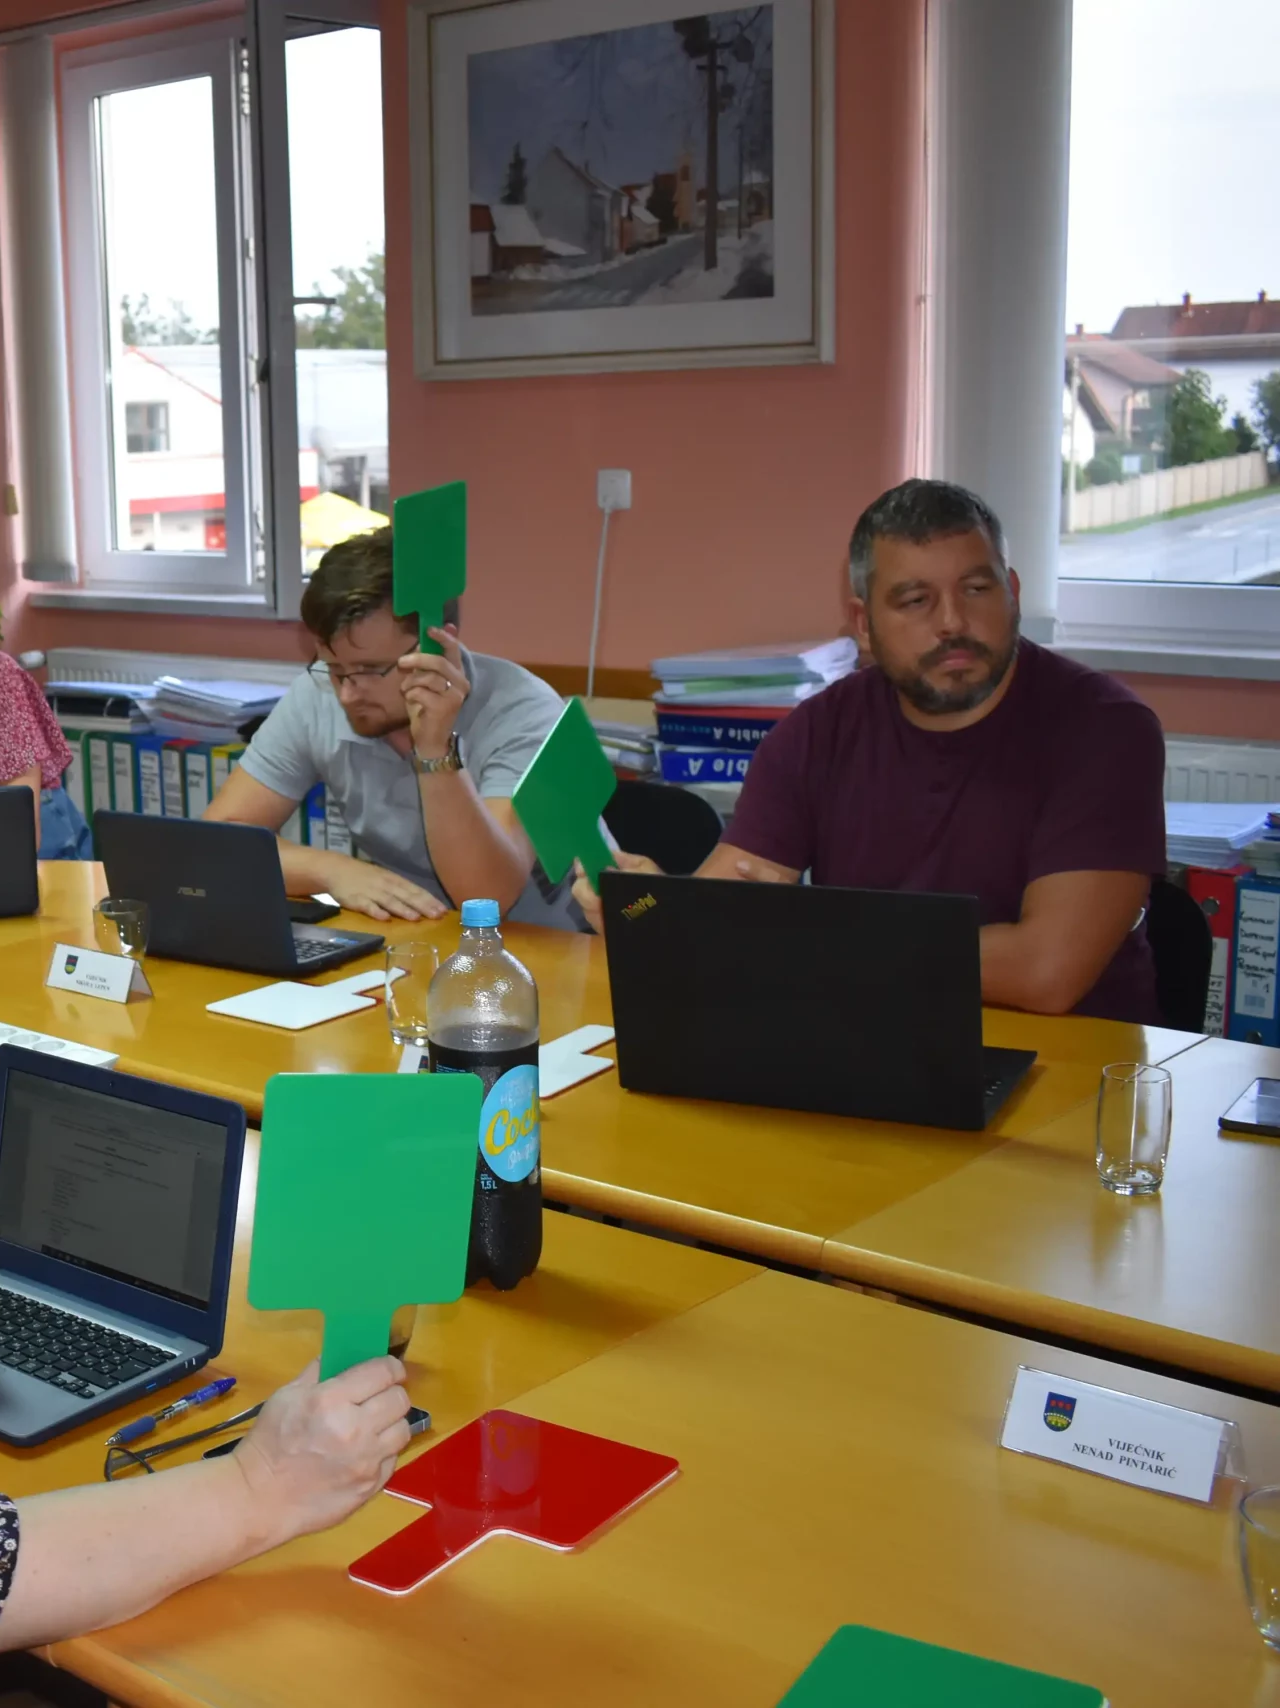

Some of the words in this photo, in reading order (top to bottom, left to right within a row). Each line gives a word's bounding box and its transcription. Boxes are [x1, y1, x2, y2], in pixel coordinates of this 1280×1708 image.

[713, 727, 723, 739] A
[728, 728, 769, 741] ouble
[688, 758, 704, 776] A
[712, 758, 749, 777] ble
[177, 887, 206, 897] ASUS
[621, 893, 657, 920] ThinkPad
[480, 1180, 492, 1190] 1,5
[492, 1180, 498, 1189] L
[1108, 1438, 1166, 1462] VIJEĆNIK
[1072, 1442, 1114, 1461] NENAD
[1119, 1455, 1177, 1479] PINTARIĆ
